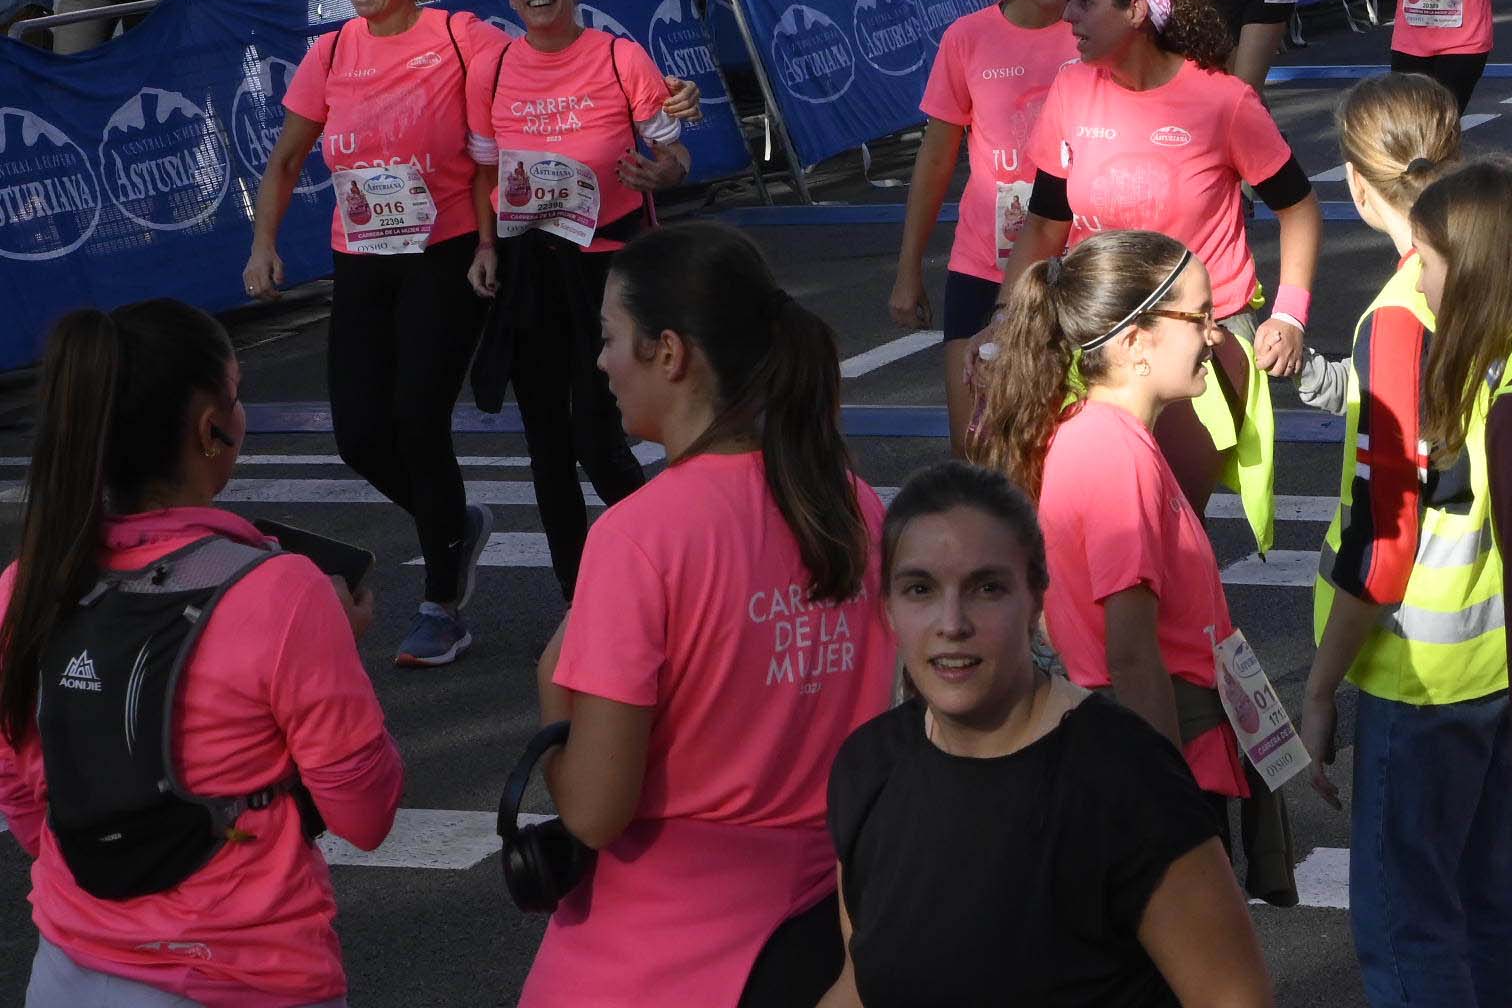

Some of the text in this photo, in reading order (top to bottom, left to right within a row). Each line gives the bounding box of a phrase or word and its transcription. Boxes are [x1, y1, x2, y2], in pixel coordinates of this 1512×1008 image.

[983, 67, 1024, 80] OYSHO
[510, 96, 595, 117] CARRERA
[329, 132, 356, 156] TU
[534, 187, 569, 200] 016
[373, 201, 405, 216] 016
[380, 217, 405, 227] 22394
[775, 610, 850, 652] DE LA
[59, 679, 102, 692] AONIJIE
